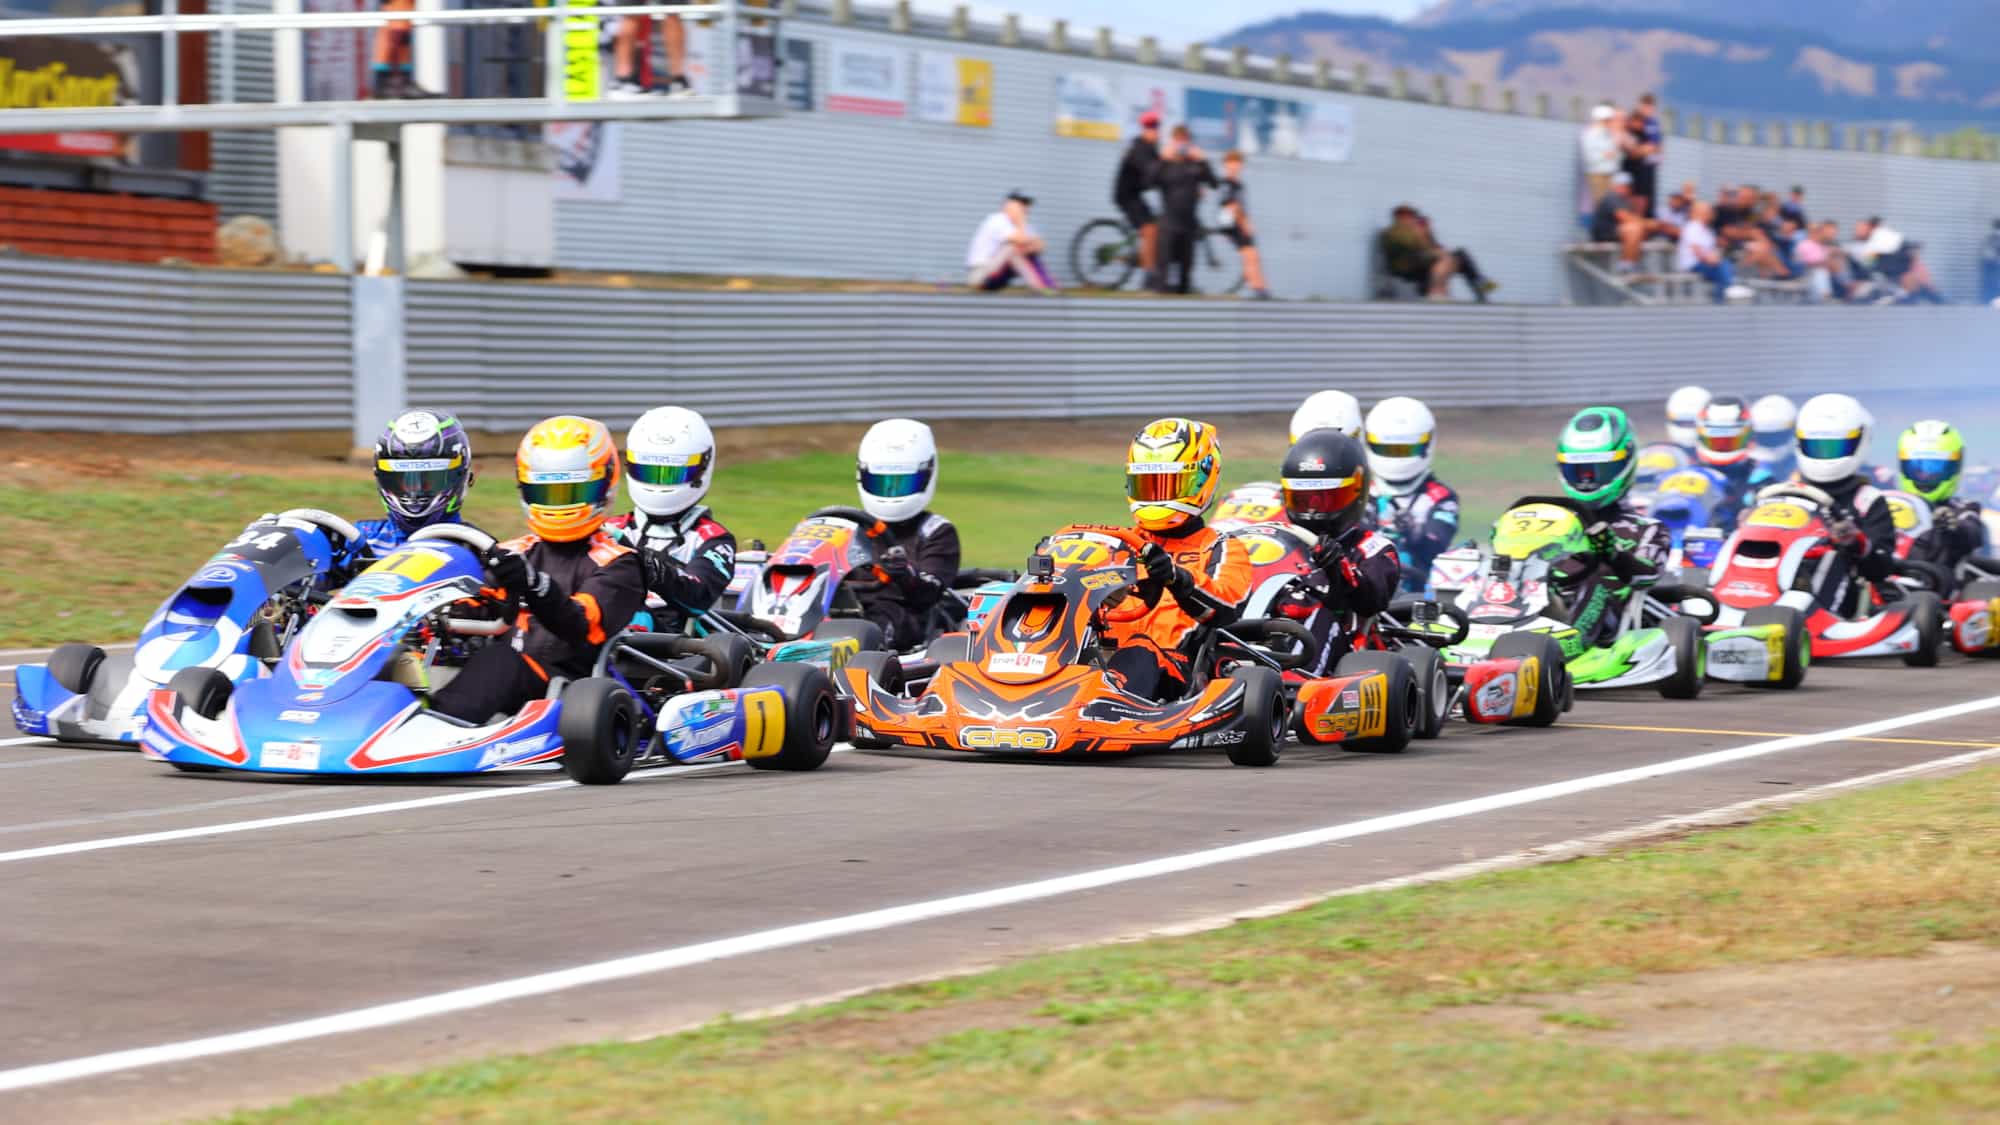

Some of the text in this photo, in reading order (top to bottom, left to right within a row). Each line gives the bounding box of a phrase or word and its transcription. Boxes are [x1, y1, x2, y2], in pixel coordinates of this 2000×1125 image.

[224, 530, 288, 550] 34
[1080, 571, 1123, 590] CRG
[757, 701, 766, 752] 1
[966, 730, 1048, 749] CRG
